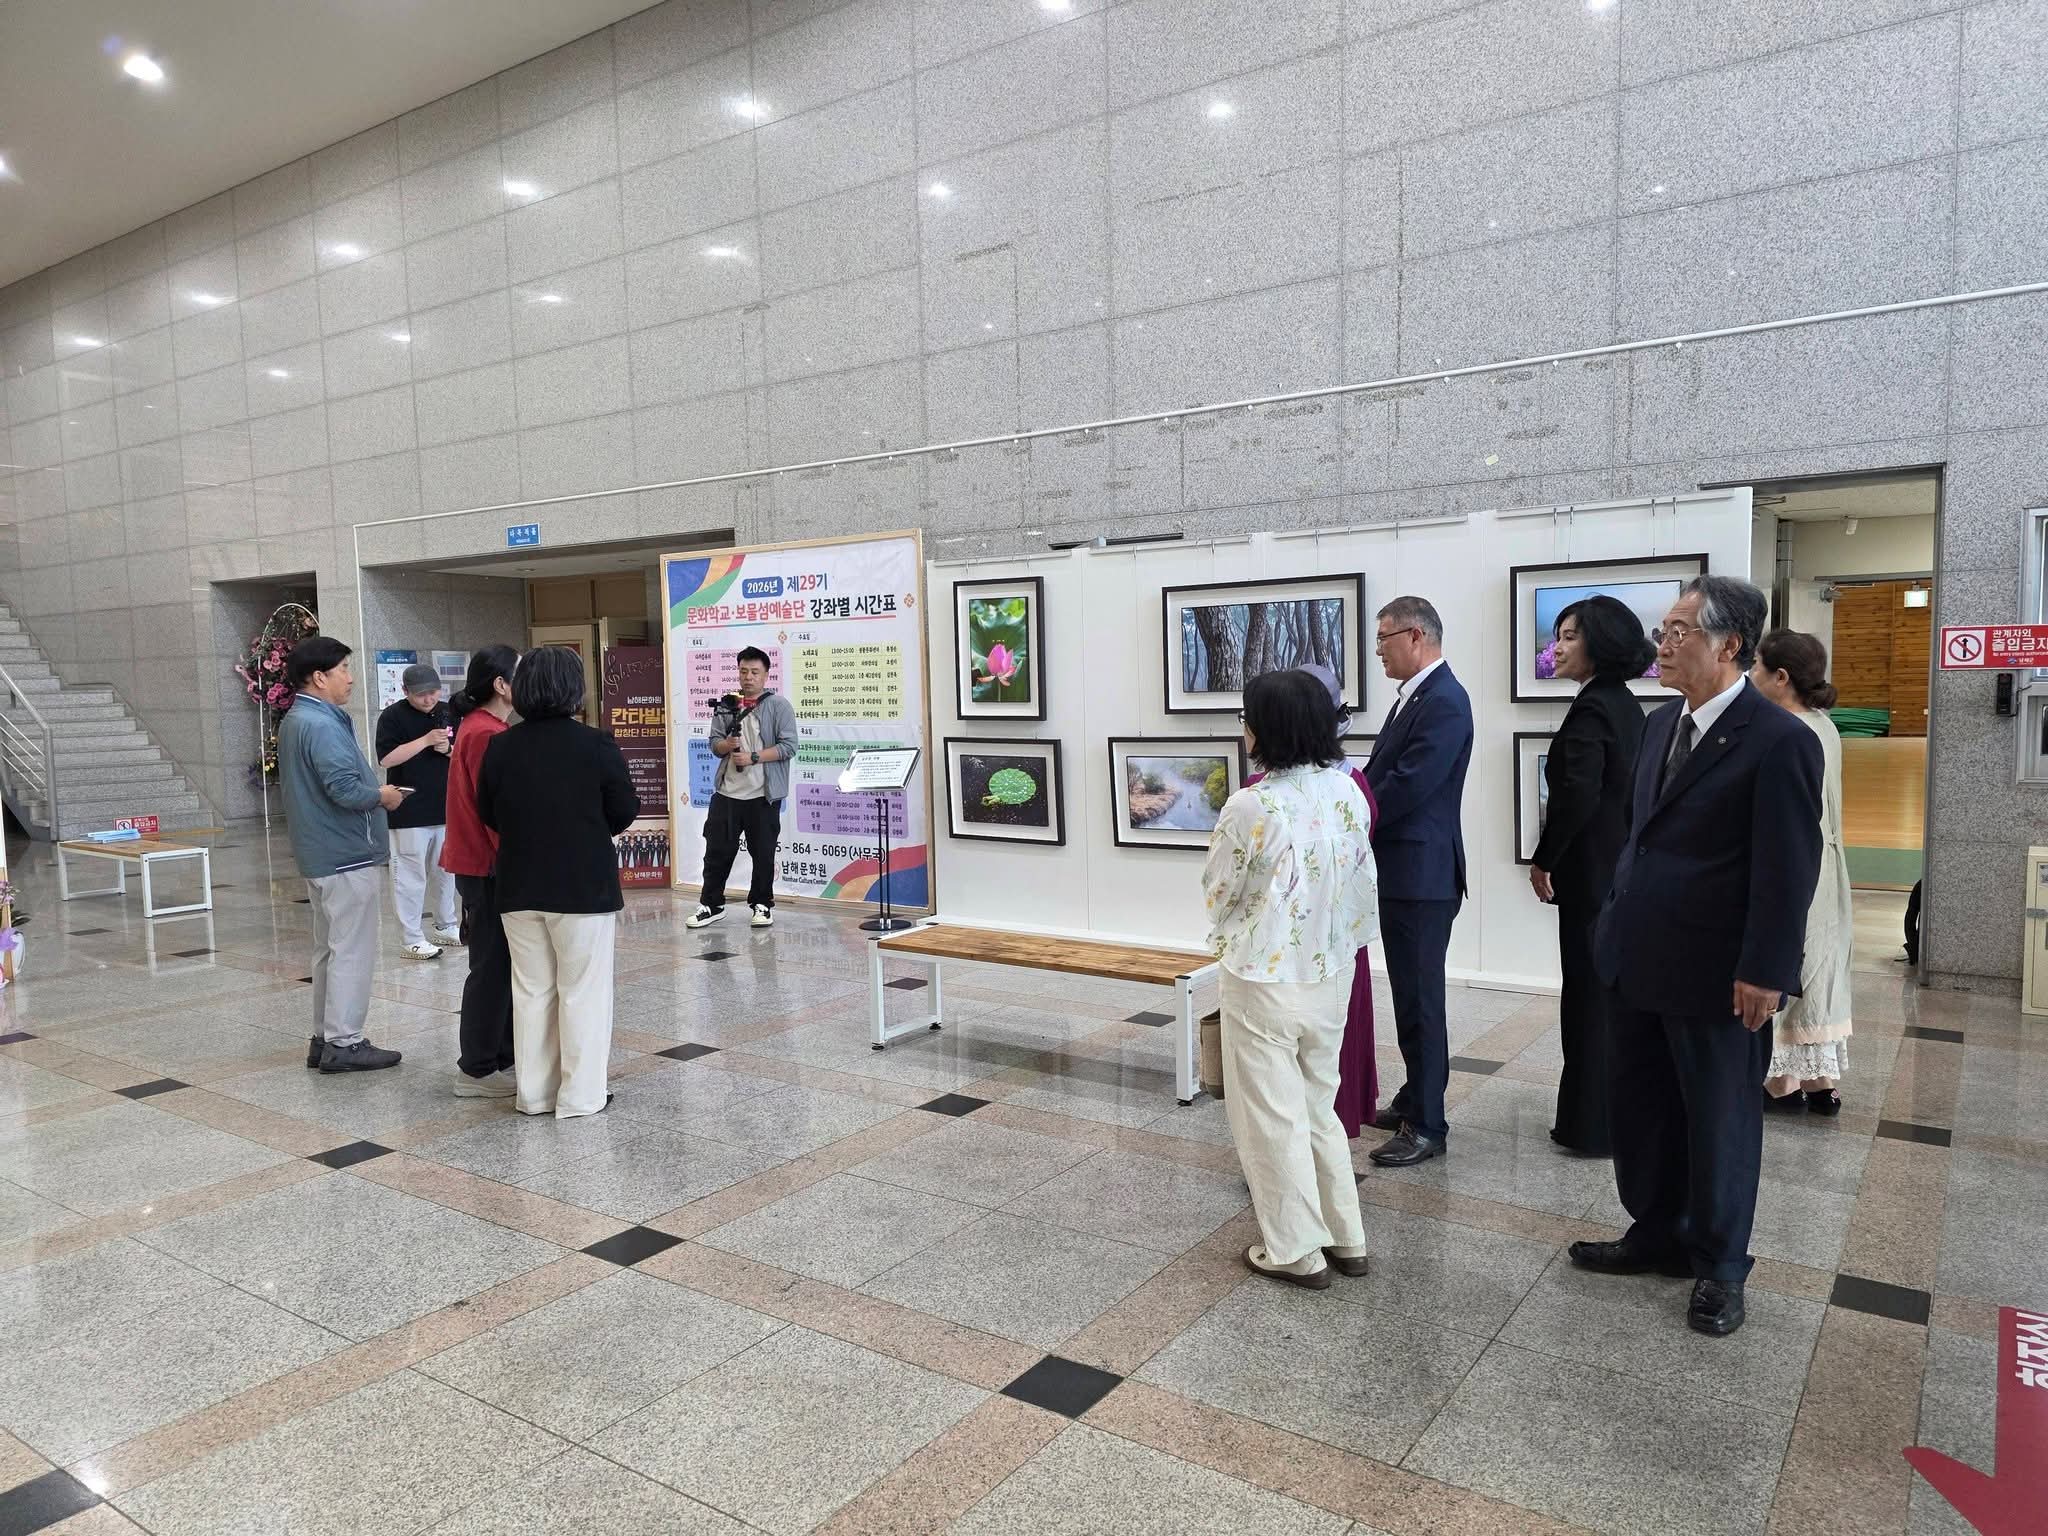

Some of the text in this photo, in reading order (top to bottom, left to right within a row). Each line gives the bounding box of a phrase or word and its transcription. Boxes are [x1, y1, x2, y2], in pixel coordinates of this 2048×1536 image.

[747, 573, 828, 594] 2026년 제29기
[810, 597, 851, 619] 강좌별
[855, 594, 897, 615] 시간표
[1992, 629, 2032, 638] 관계자외
[627, 696, 662, 704] 남해문화원
[611, 707, 665, 725] 칸타빌
[792, 842, 811, 855] 864
[822, 844, 847, 858] 6069
[849, 845, 886, 863] (사무국)
[781, 860, 827, 878] 남해문화원
